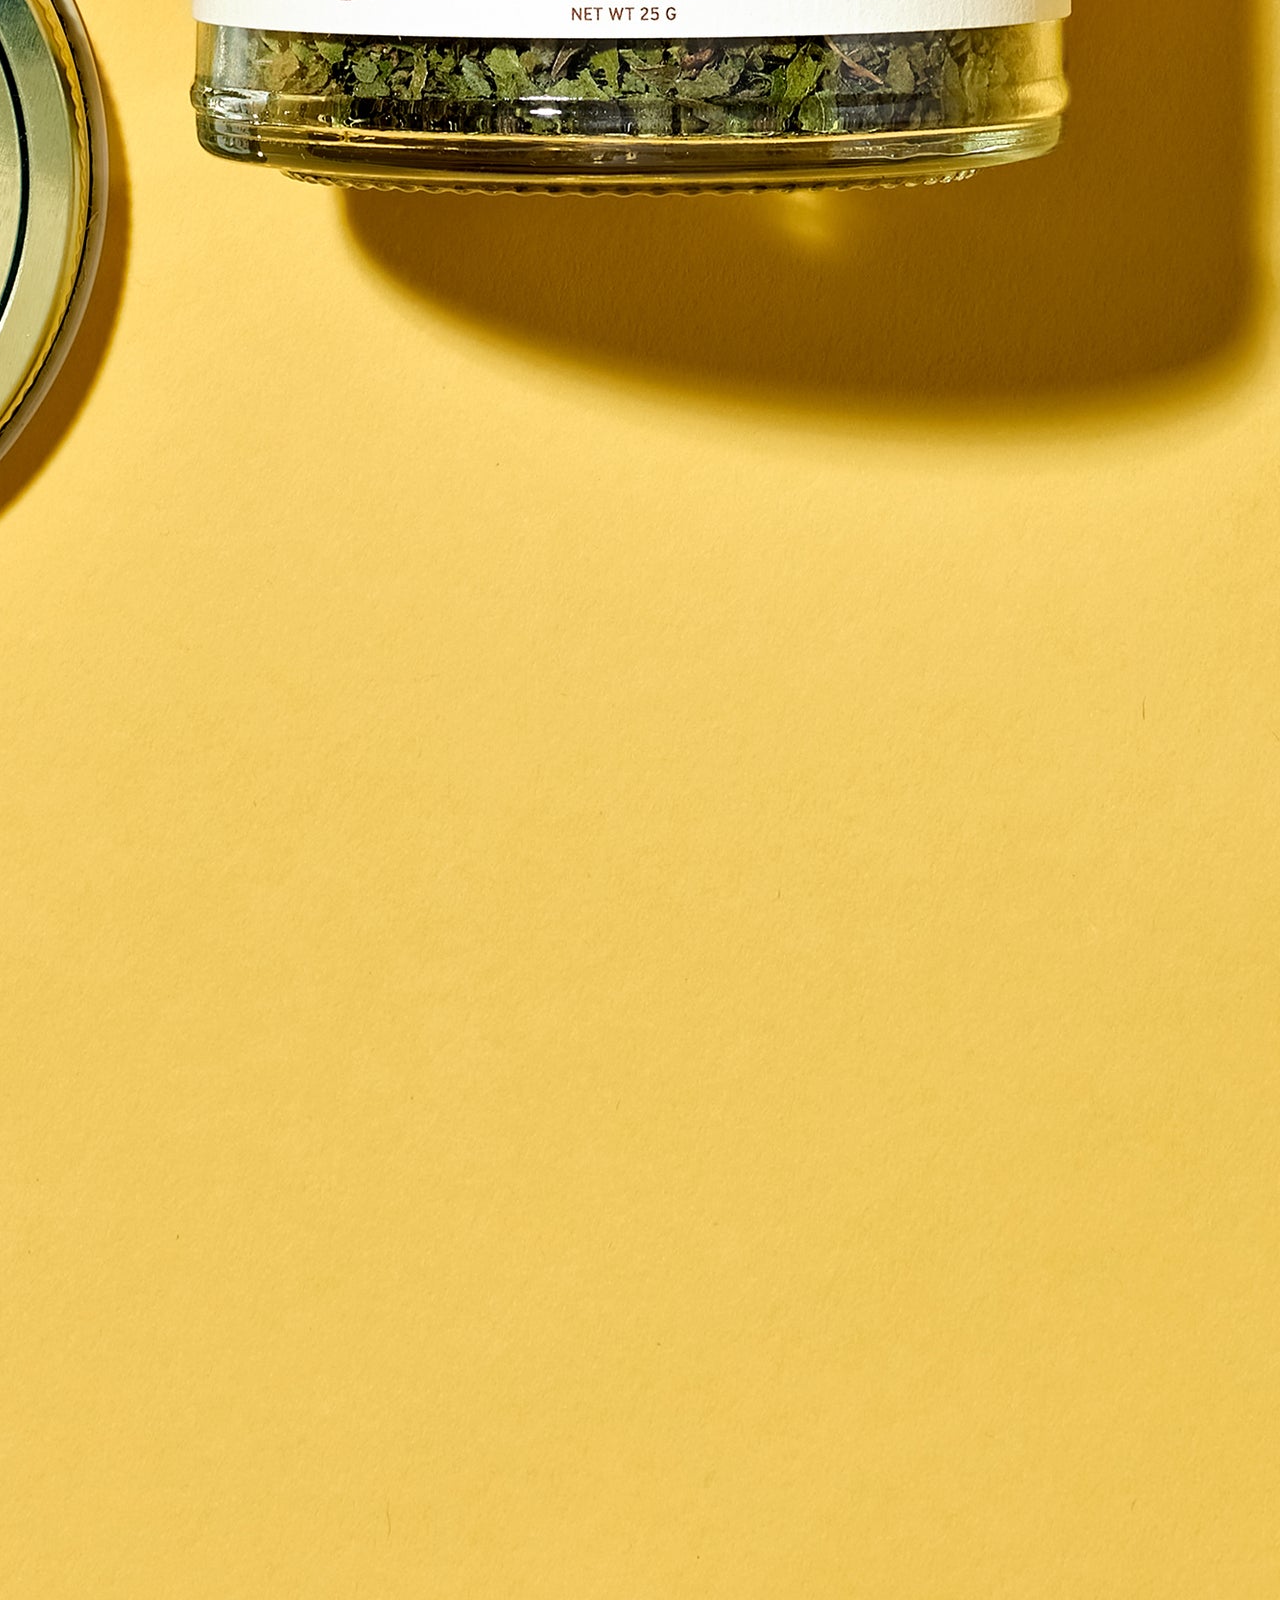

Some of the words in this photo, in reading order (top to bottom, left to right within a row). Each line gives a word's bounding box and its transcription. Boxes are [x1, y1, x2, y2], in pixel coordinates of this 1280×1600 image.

[571, 7, 603, 21] NET
[608, 7, 635, 21] WT
[640, 7, 660, 21] 25
[665, 7, 677, 21] G
